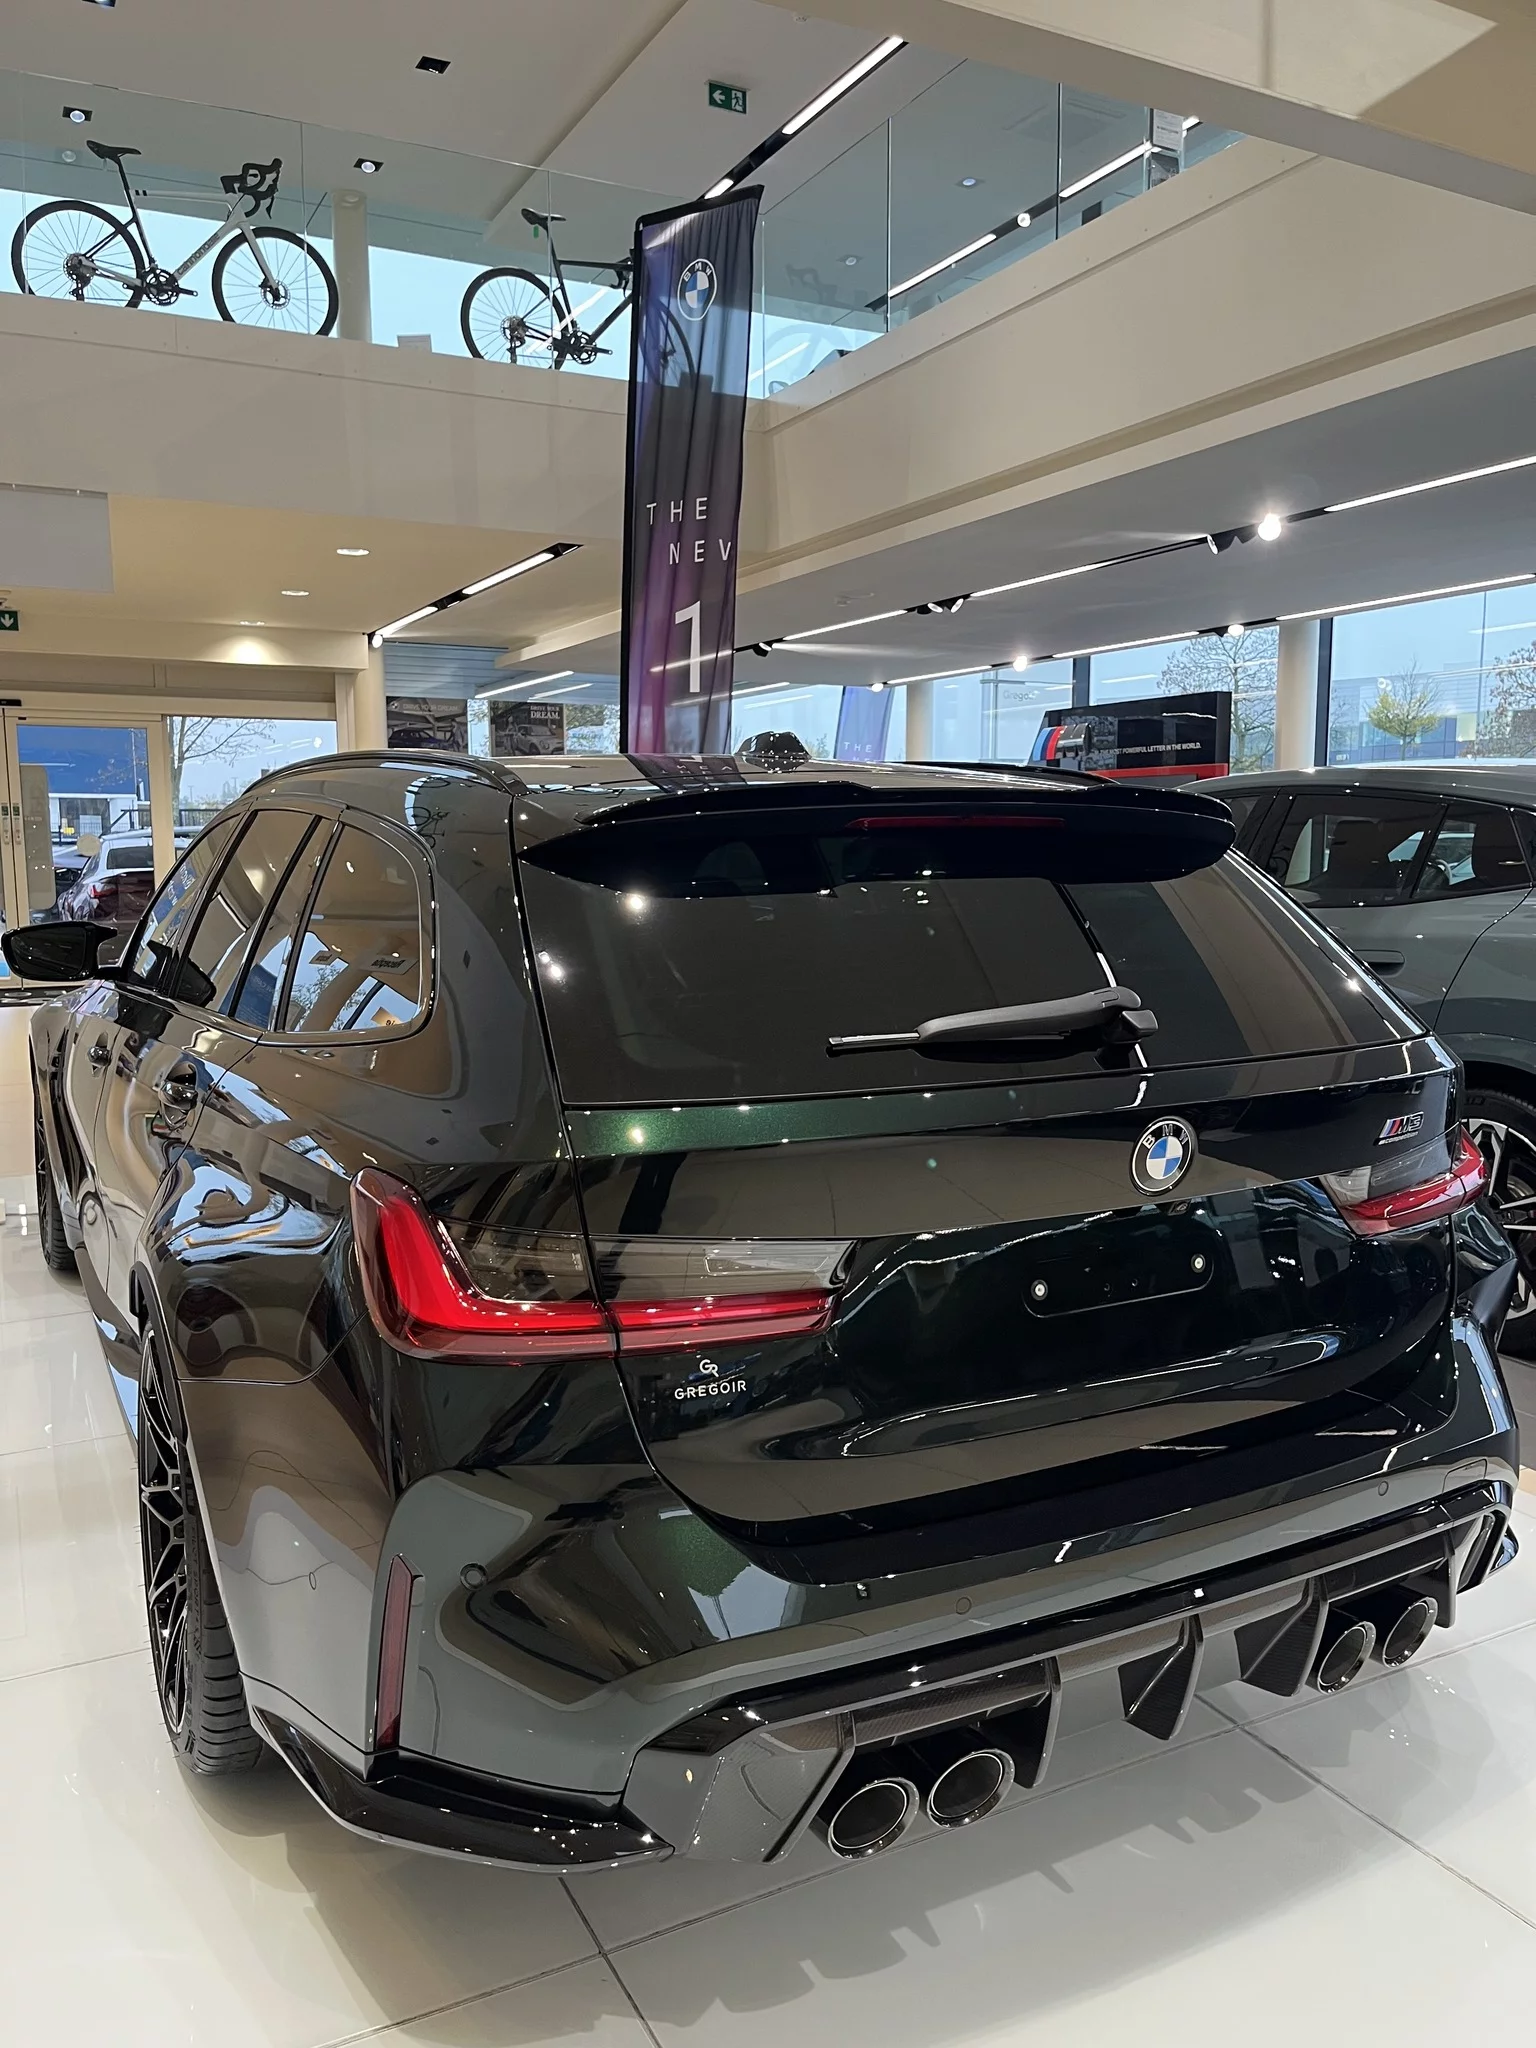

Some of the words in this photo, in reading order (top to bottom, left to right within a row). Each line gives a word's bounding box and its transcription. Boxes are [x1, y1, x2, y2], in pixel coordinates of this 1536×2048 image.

[177, 232, 221, 276] cannondale
[683, 261, 713, 282] BMW
[646, 497, 708, 525] THE
[674, 600, 700, 693] 1
[843, 741, 872, 753] THE
[1123, 746, 1147, 754] POWERFUL
[1148, 744, 1165, 752] LETTER
[1182, 742, 1202, 750] WORLD.
[1388, 1111, 1424, 1135] M3
[1142, 1123, 1189, 1149] BMW
[674, 1380, 747, 1400] GREGOIR
